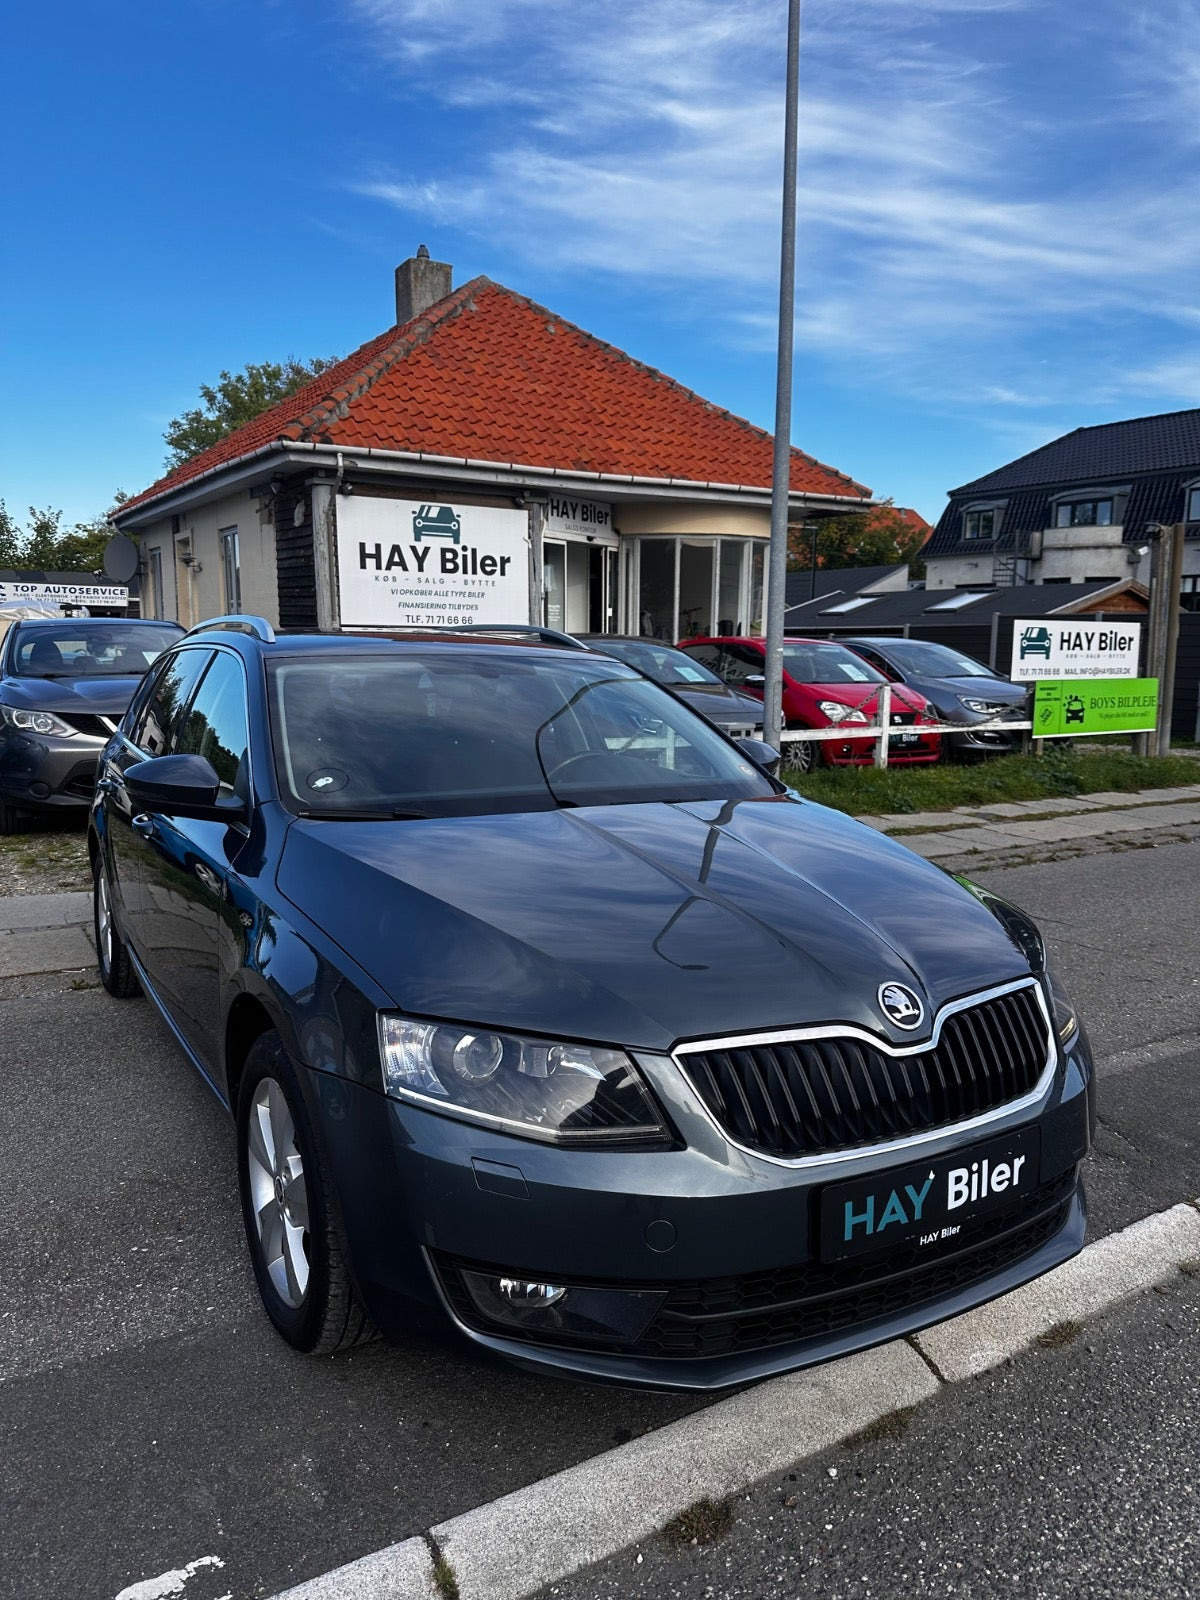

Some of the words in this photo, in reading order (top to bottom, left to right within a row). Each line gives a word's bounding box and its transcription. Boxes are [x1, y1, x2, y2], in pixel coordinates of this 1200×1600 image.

[550, 498, 578, 520] HAY
[581, 503, 609, 525] Biler
[358, 541, 431, 573] HAY
[440, 545, 511, 576] Biler
[375, 575, 398, 583] KØB
[417, 577, 445, 585] SALG
[464, 578, 496, 587] BYTTE
[13, 584, 38, 593] TOP
[44, 586, 126, 596] AUTOSERVICE
[391, 588, 398, 596] VI
[399, 589, 433, 597] OPKØBER
[450, 590, 467, 598] TYPE
[398, 601, 447, 610] FINANSIERING
[448, 603, 479, 611] TILBYDES
[405, 614, 424, 624] TLF.
[425, 615, 434, 624] 71
[436, 615, 445, 624] 71
[447, 615, 459, 624] 66
[461, 615, 473, 624] 66
[1059, 631, 1095, 651] HAY
[1098, 630, 1134, 651] Biler
[1090, 696, 1116, 709] BOYS
[1117, 695, 1157, 708] BILPLEJE
[902, 732, 918, 742] Biler
[844, 1177, 934, 1241] HAY
[947, 1154, 1026, 1211] Biler
[919, 1230, 940, 1246] HAY
[940, 1224, 961, 1239] Biler
